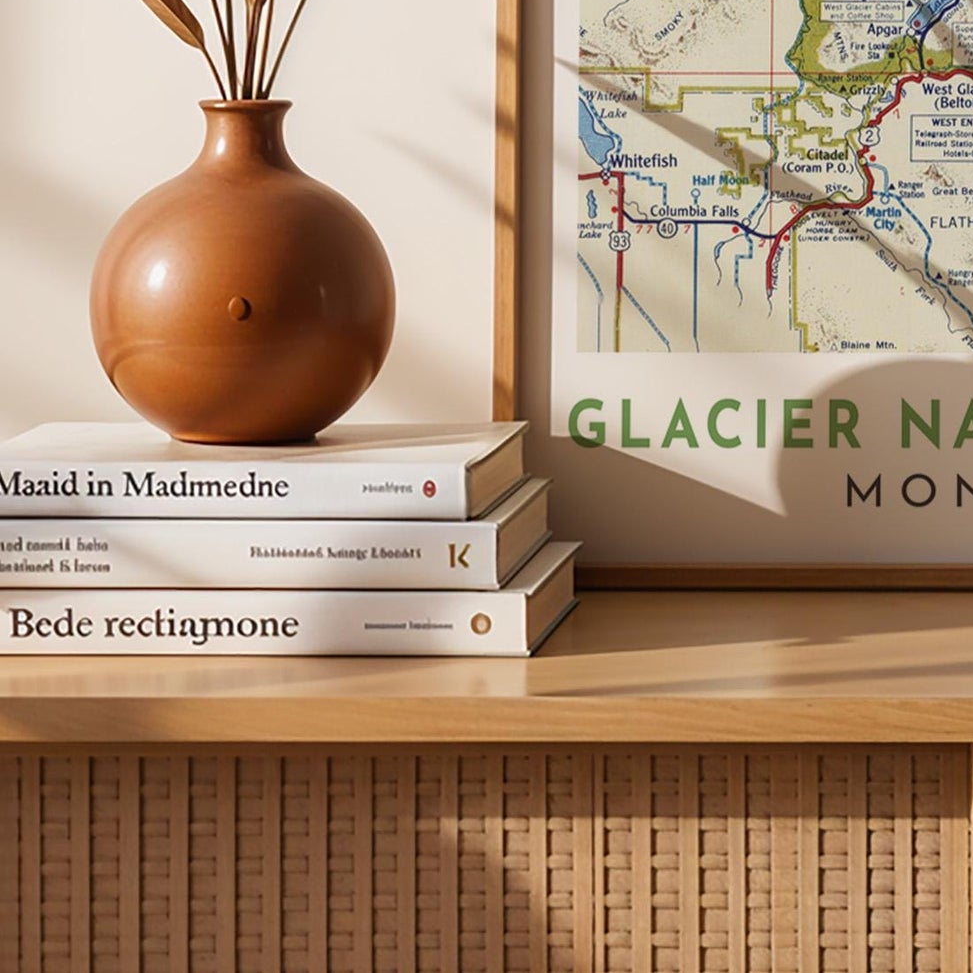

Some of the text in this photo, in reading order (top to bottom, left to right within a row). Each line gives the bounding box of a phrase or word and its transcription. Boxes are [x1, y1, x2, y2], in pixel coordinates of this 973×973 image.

[655, 11, 684, 41] SMOKY
[868, 24, 902, 37] Apgar
[851, 86, 885, 95] Grizzly
[923, 85, 951, 95] West
[586, 91, 637, 101] Whitefish
[601, 109, 626, 118] Lake
[866, 131, 873, 142] 2
[807, 150, 848, 160] Citadel
[610, 155, 677, 168] Whitefish
[782, 163, 854, 174] (Coram P.O.)
[693, 176, 714, 185] Half
[933, 187, 957, 195] Great
[651, 205, 739, 218] Columbia Falls
[866, 208, 901, 217] Martin
[661, 224, 674, 233] 40
[874, 219, 895, 231] City
[613, 236, 627, 247] 93
[568, 397, 862, 449] GLACIER
[87, 471, 114, 497] in
[9, 608, 94, 638] Bede
